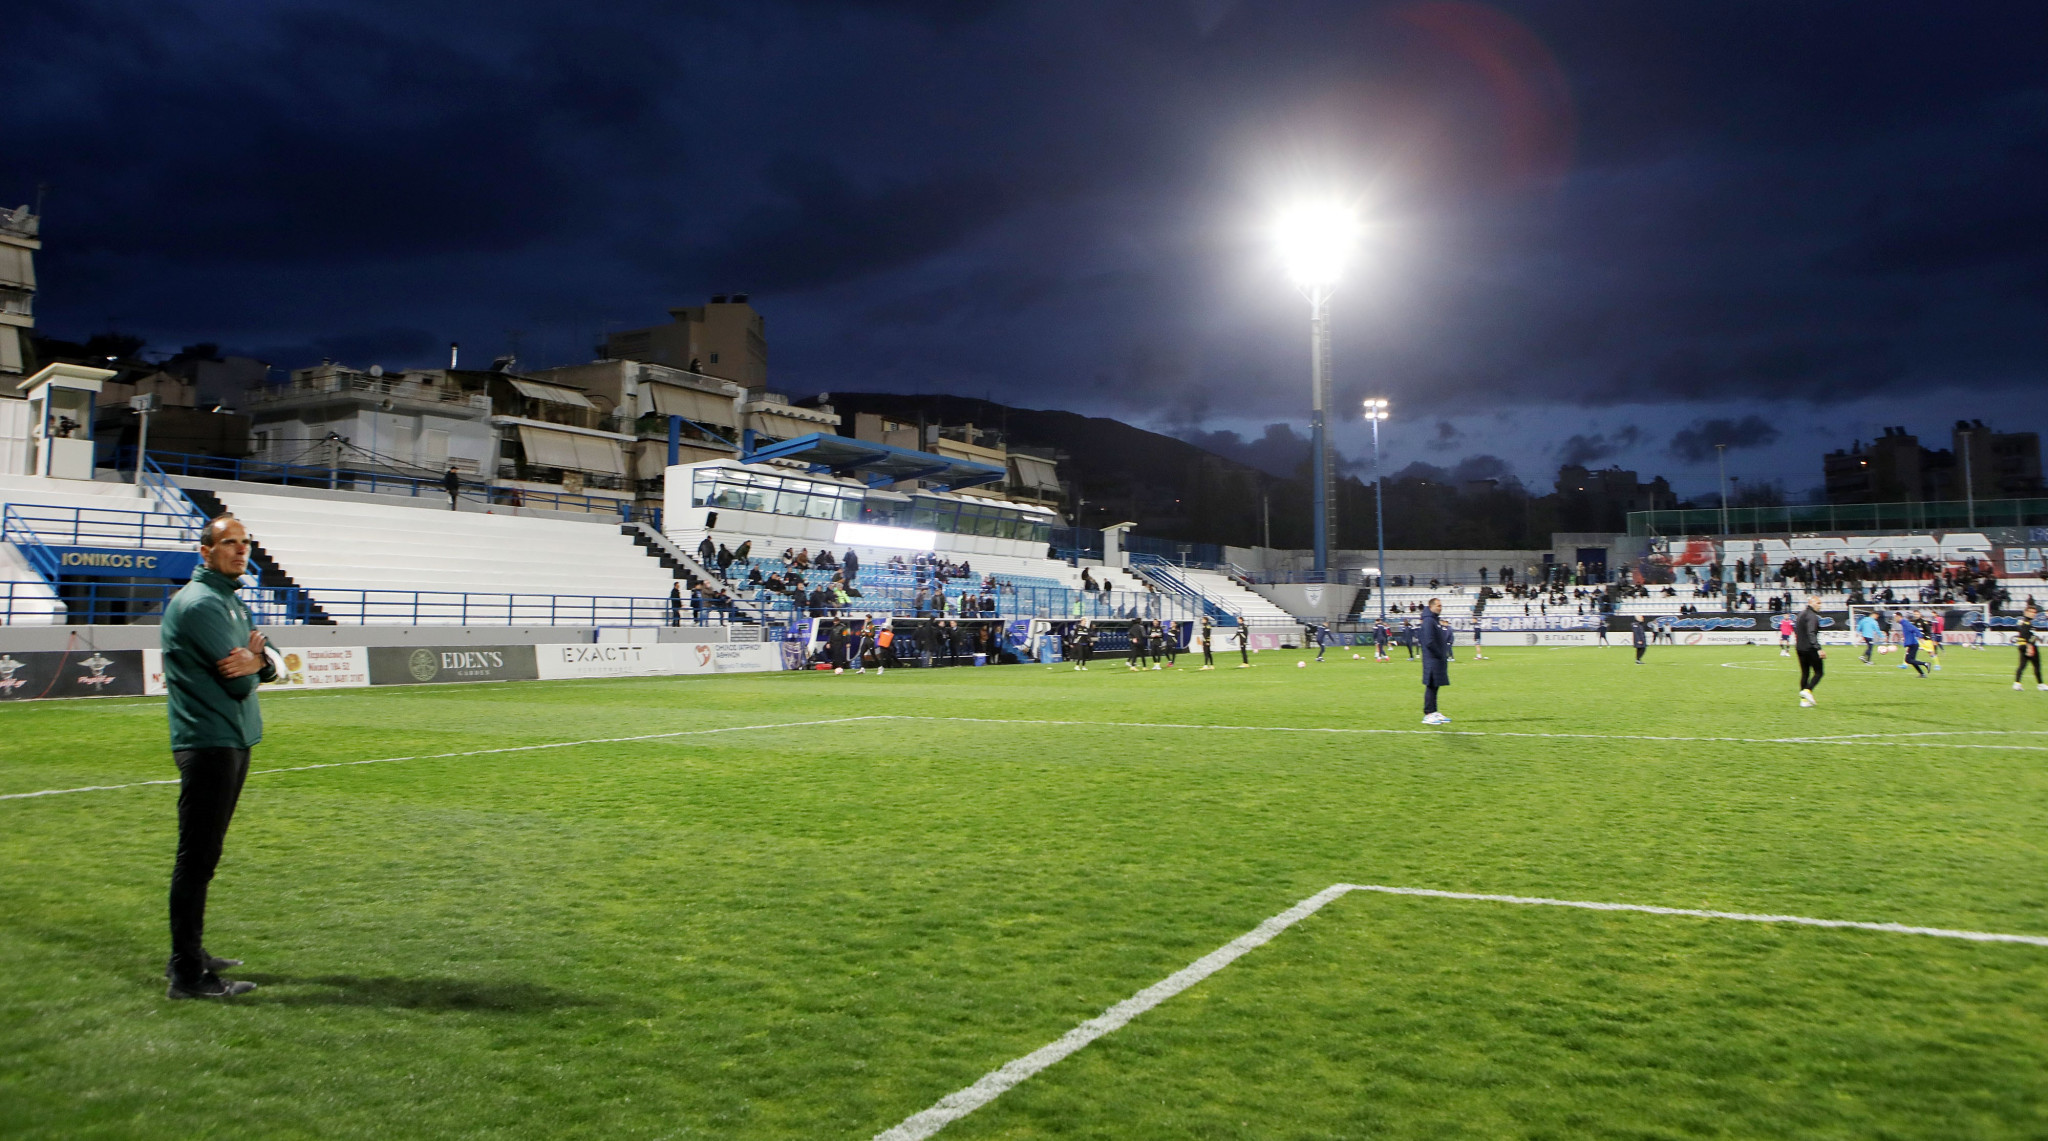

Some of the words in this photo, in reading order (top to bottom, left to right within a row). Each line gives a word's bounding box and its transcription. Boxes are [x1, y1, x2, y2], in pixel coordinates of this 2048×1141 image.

[62, 552, 133, 568] IONIKOS
[136, 555, 157, 569] FC
[441, 651, 503, 668] EDEN'S
[562, 647, 642, 662] EXACTT
